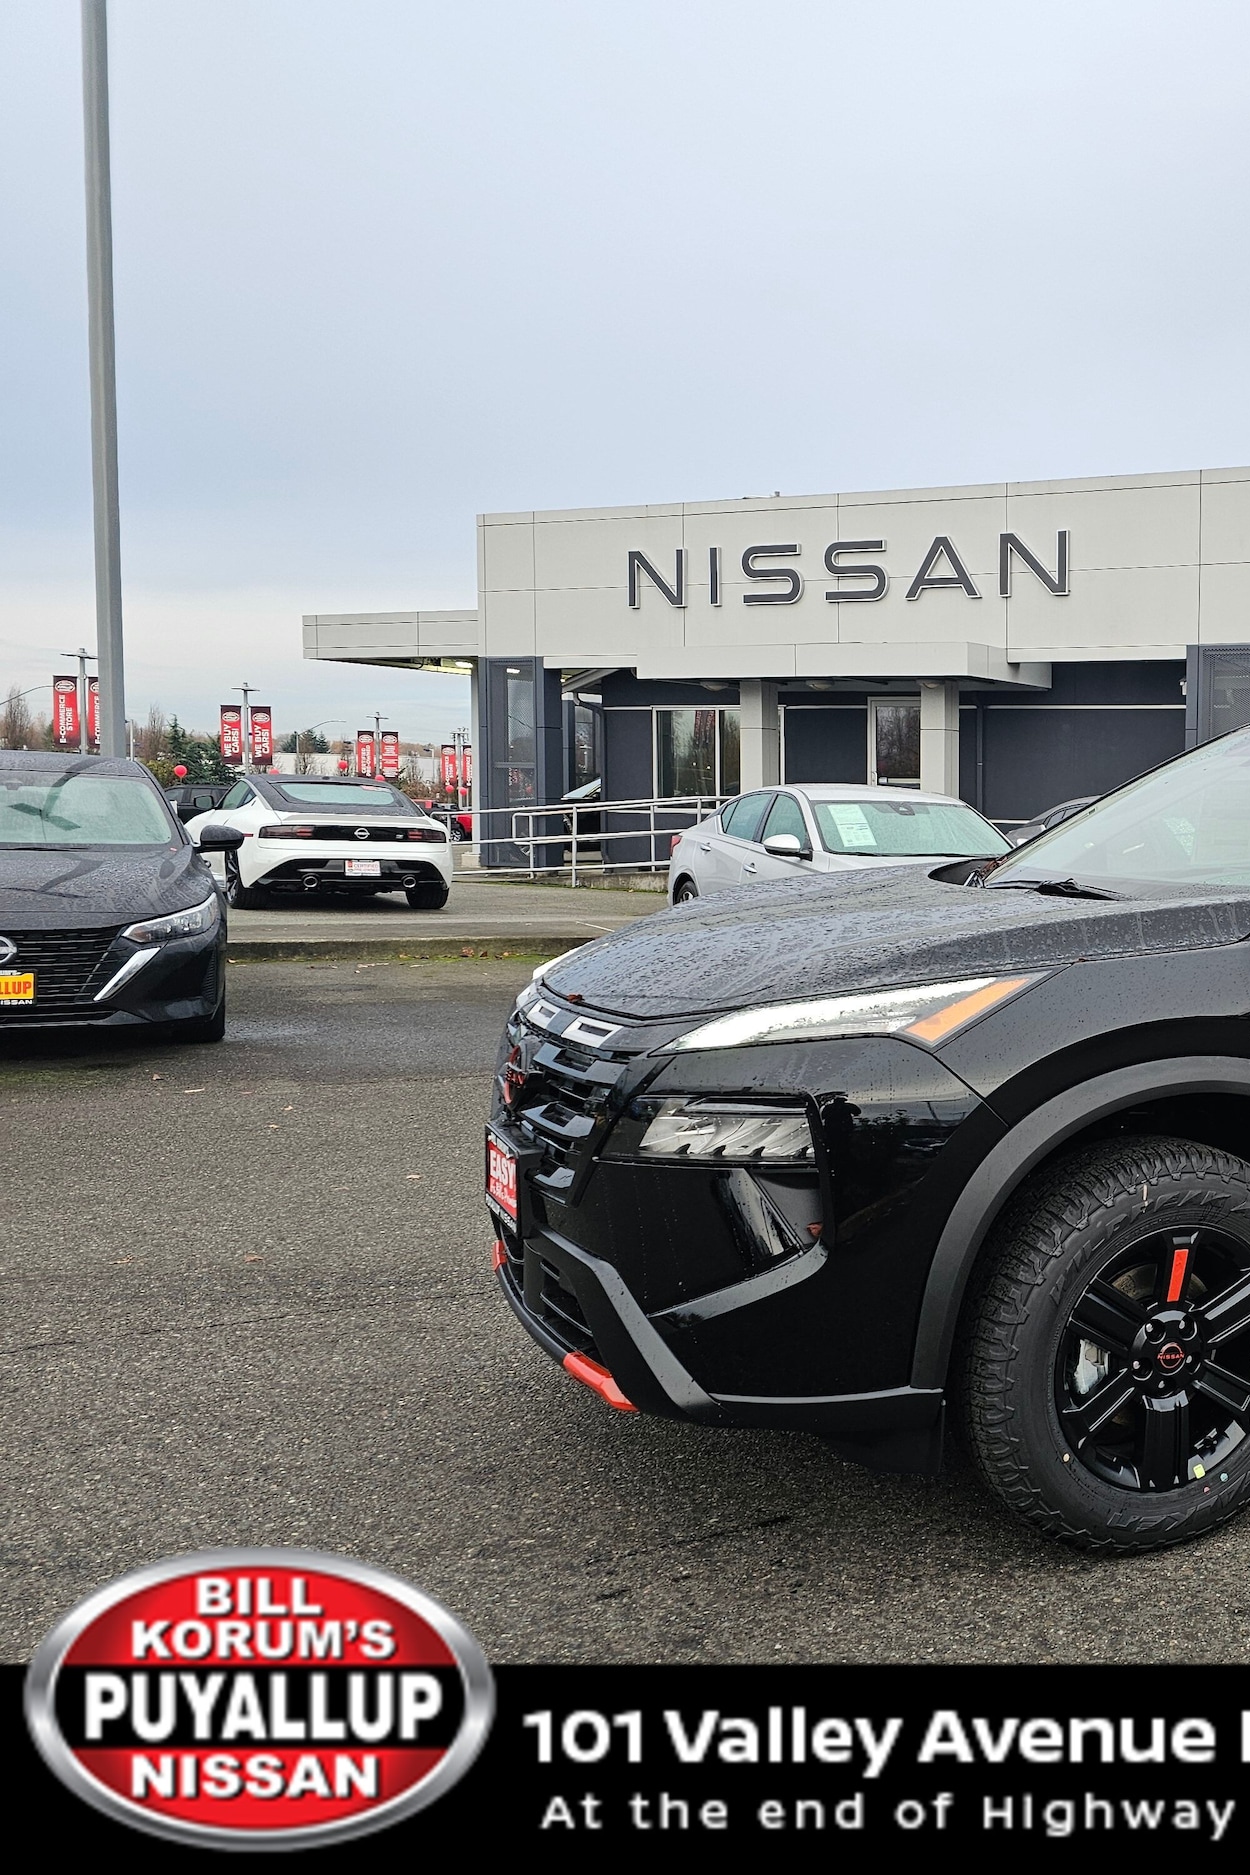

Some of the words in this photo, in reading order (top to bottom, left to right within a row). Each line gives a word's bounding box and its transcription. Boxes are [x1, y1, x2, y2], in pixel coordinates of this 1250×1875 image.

[628, 530, 1072, 608] NISSAN
[223, 724, 231, 742] BUY
[253, 725, 262, 743] BUY
[224, 743, 232, 757] WE
[254, 744, 262, 758] WE
